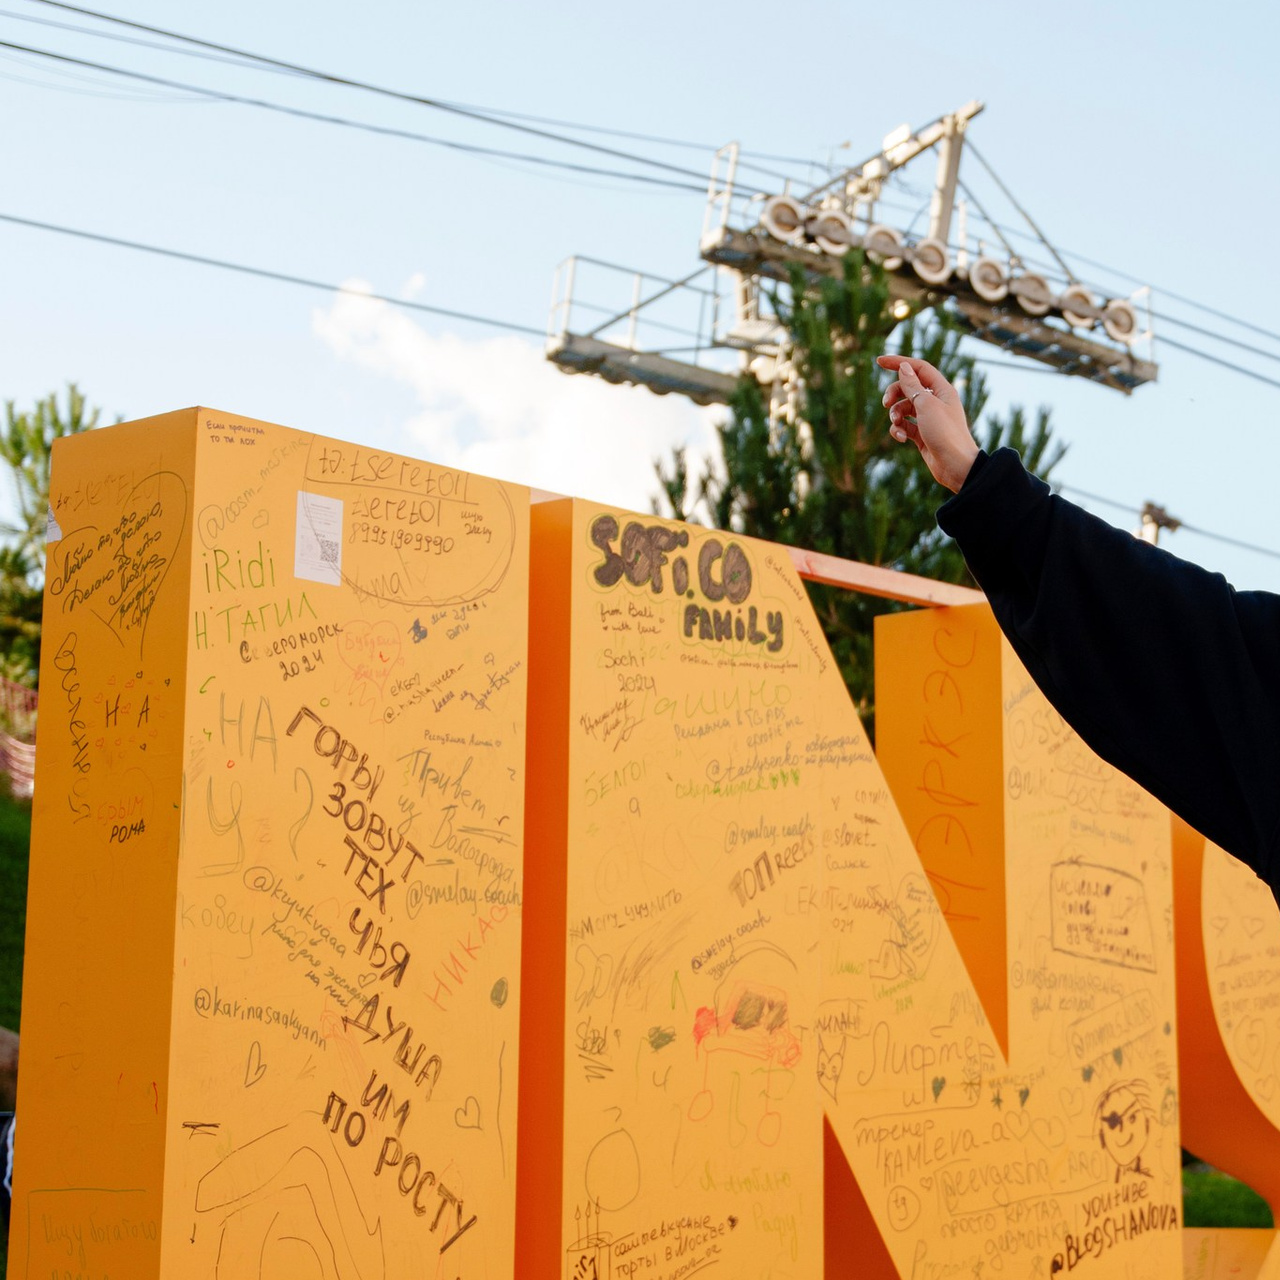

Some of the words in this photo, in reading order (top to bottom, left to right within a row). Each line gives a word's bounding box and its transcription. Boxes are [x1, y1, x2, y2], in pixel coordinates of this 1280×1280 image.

[279, 649, 325, 682] 2024
[603, 647, 646, 669] Sochi
[108, 818, 146, 844] РОМА
[322, 781, 426, 884] ЗОВУТ
[348, 906, 411, 989] ЧЬЯ
[341, 993, 443, 1103] ДУША
[320, 1090, 368, 1148] ПО
[373, 1135, 478, 1256] РОСТУ
